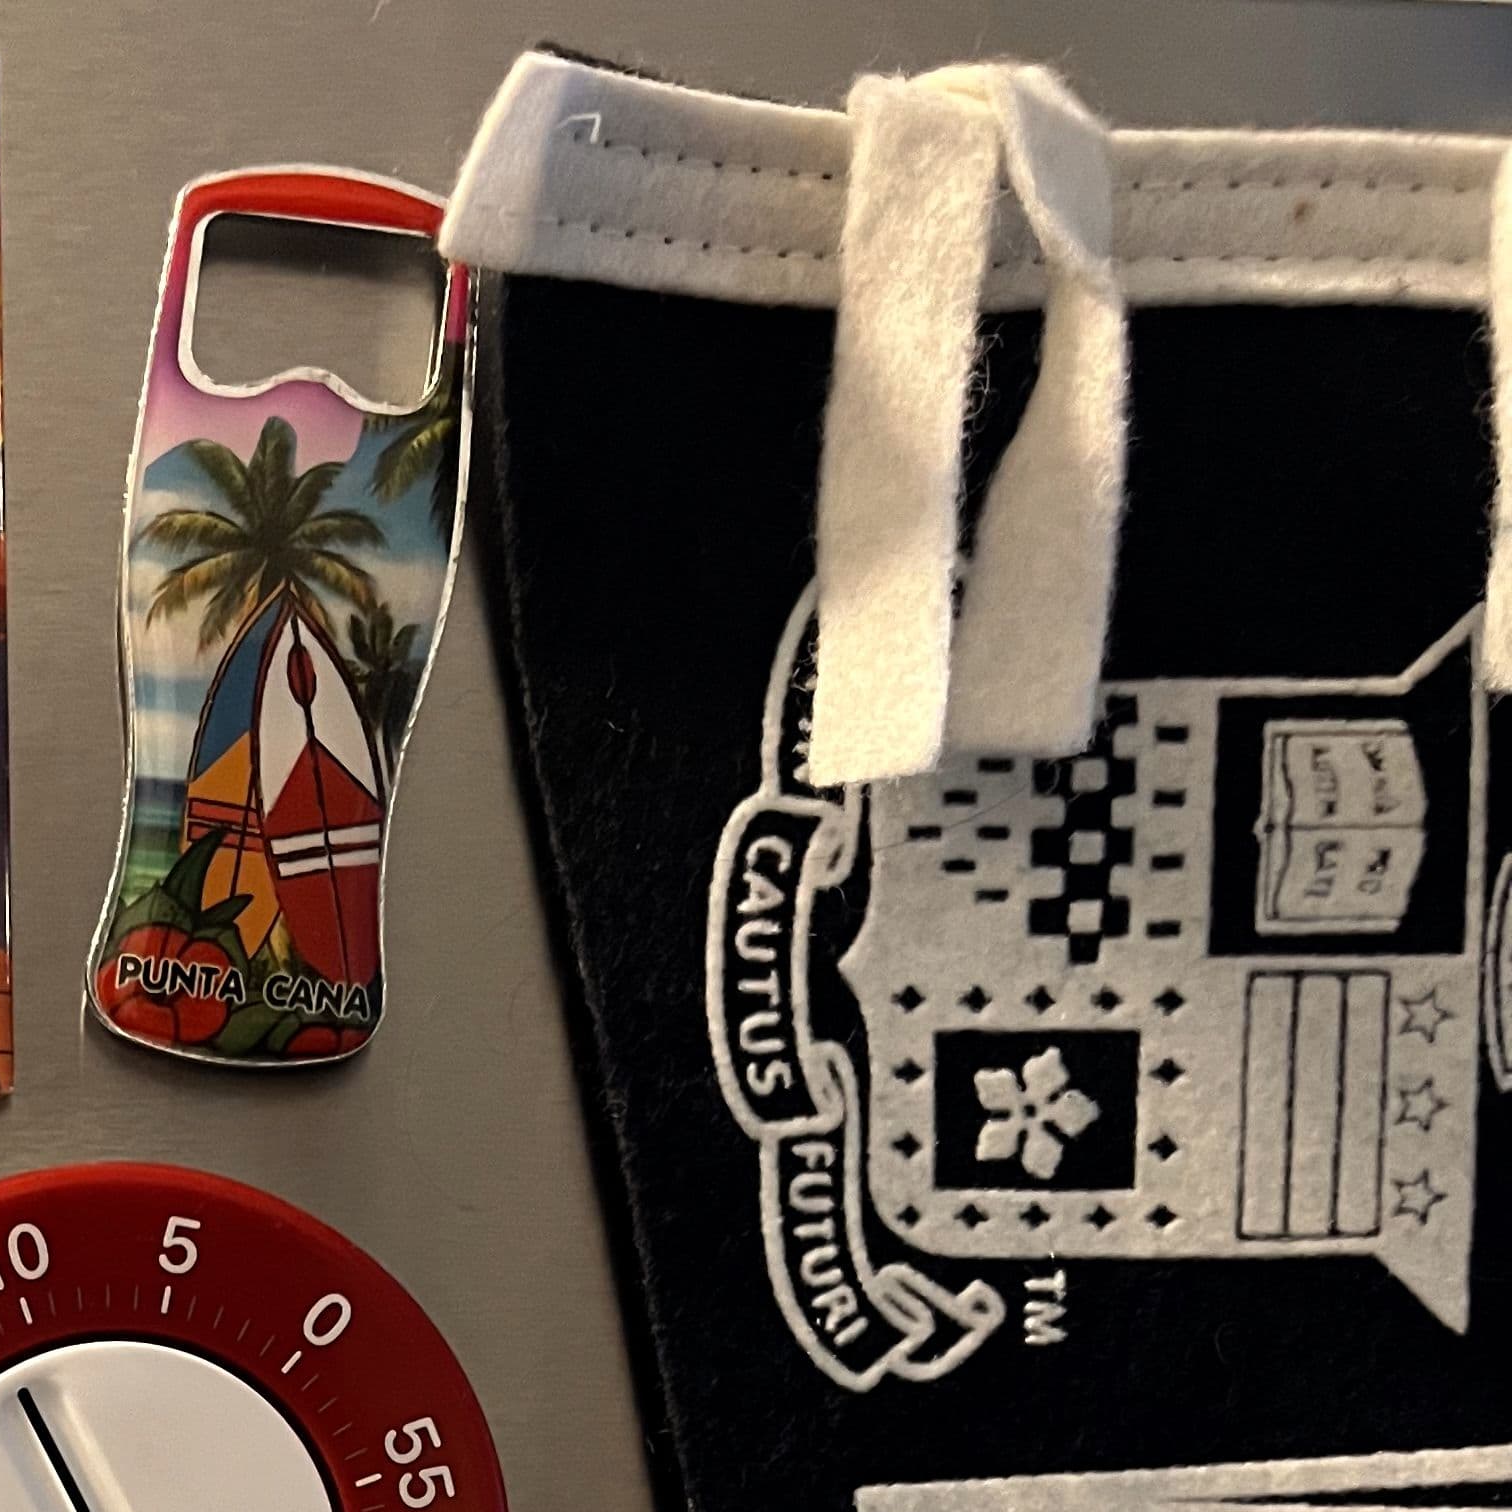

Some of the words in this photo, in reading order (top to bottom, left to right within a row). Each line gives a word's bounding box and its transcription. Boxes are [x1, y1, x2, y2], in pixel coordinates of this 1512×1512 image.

[116, 953, 246, 1003] PUNTA
[263, 974, 370, 1021] CANA
[733, 836, 794, 1099] CAUTUS
[158, 1216, 202, 1274] 5
[774, 1140, 868, 1345] FUTURI
[303, 1292, 352, 1346] 0
[385, 1416, 455, 1510] 55
